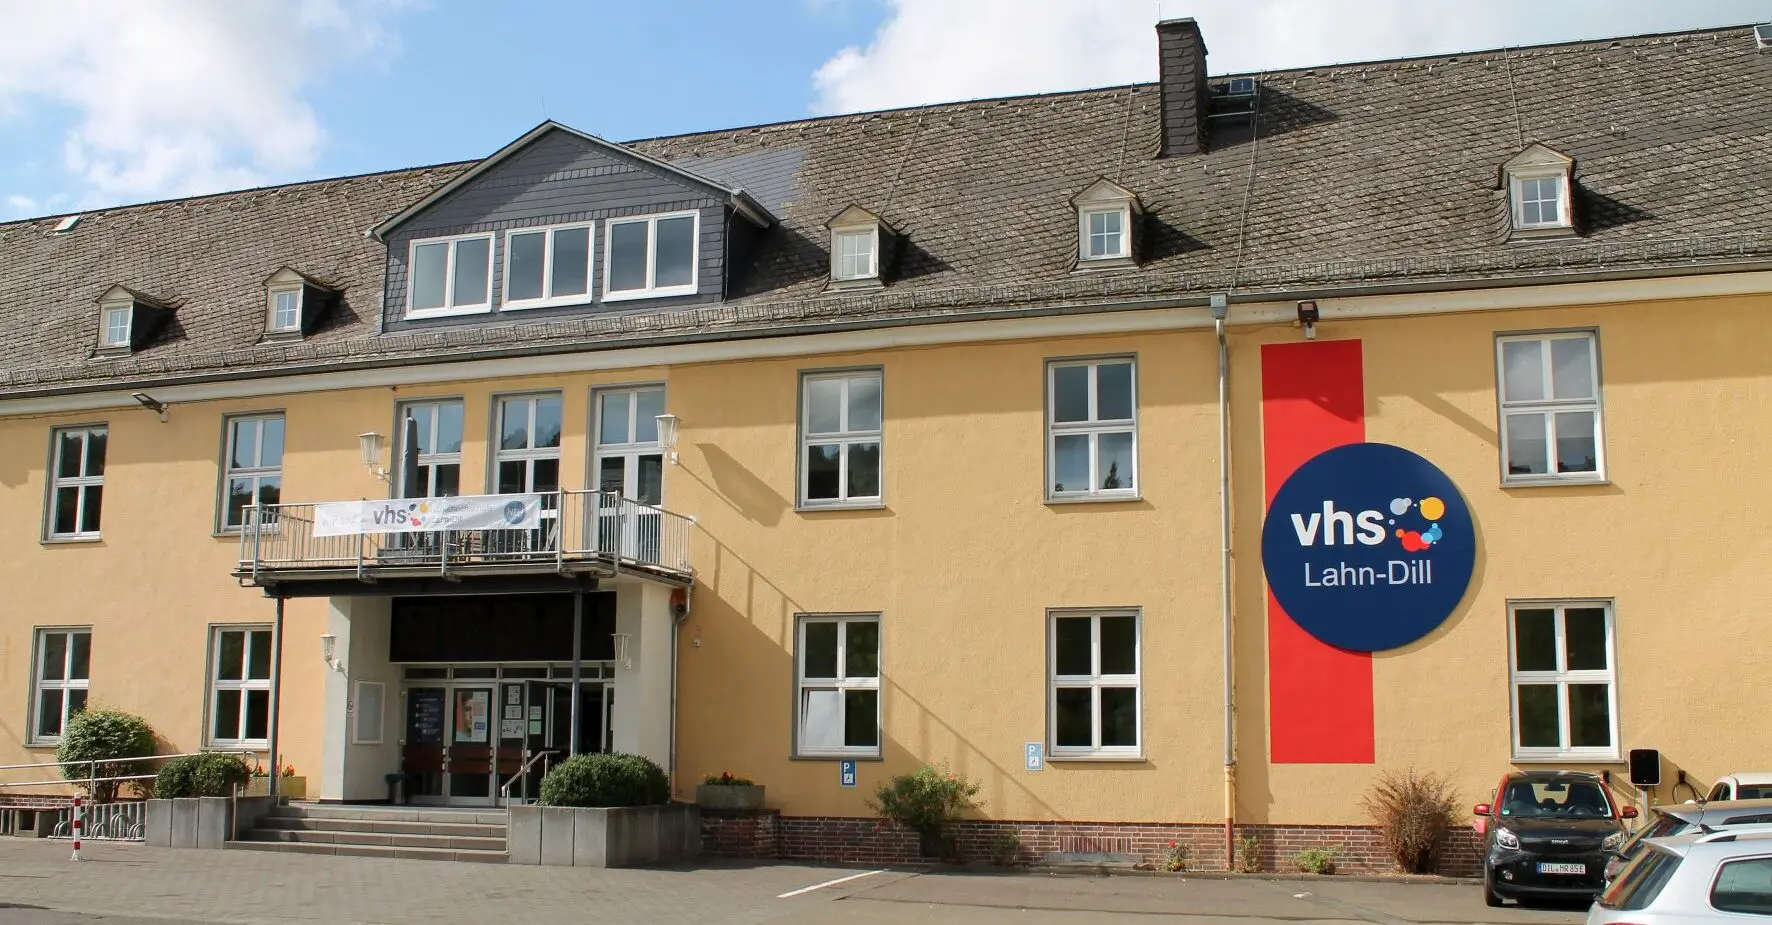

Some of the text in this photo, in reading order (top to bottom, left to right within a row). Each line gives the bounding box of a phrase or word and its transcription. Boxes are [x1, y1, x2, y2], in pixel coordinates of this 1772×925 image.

[373, 505, 407, 525] vhs
[1290, 500, 1386, 546] vhs
[1305, 559, 1432, 587] Lahn-Dill
[1029, 745, 1036, 756] P
[843, 762, 850, 773] P
